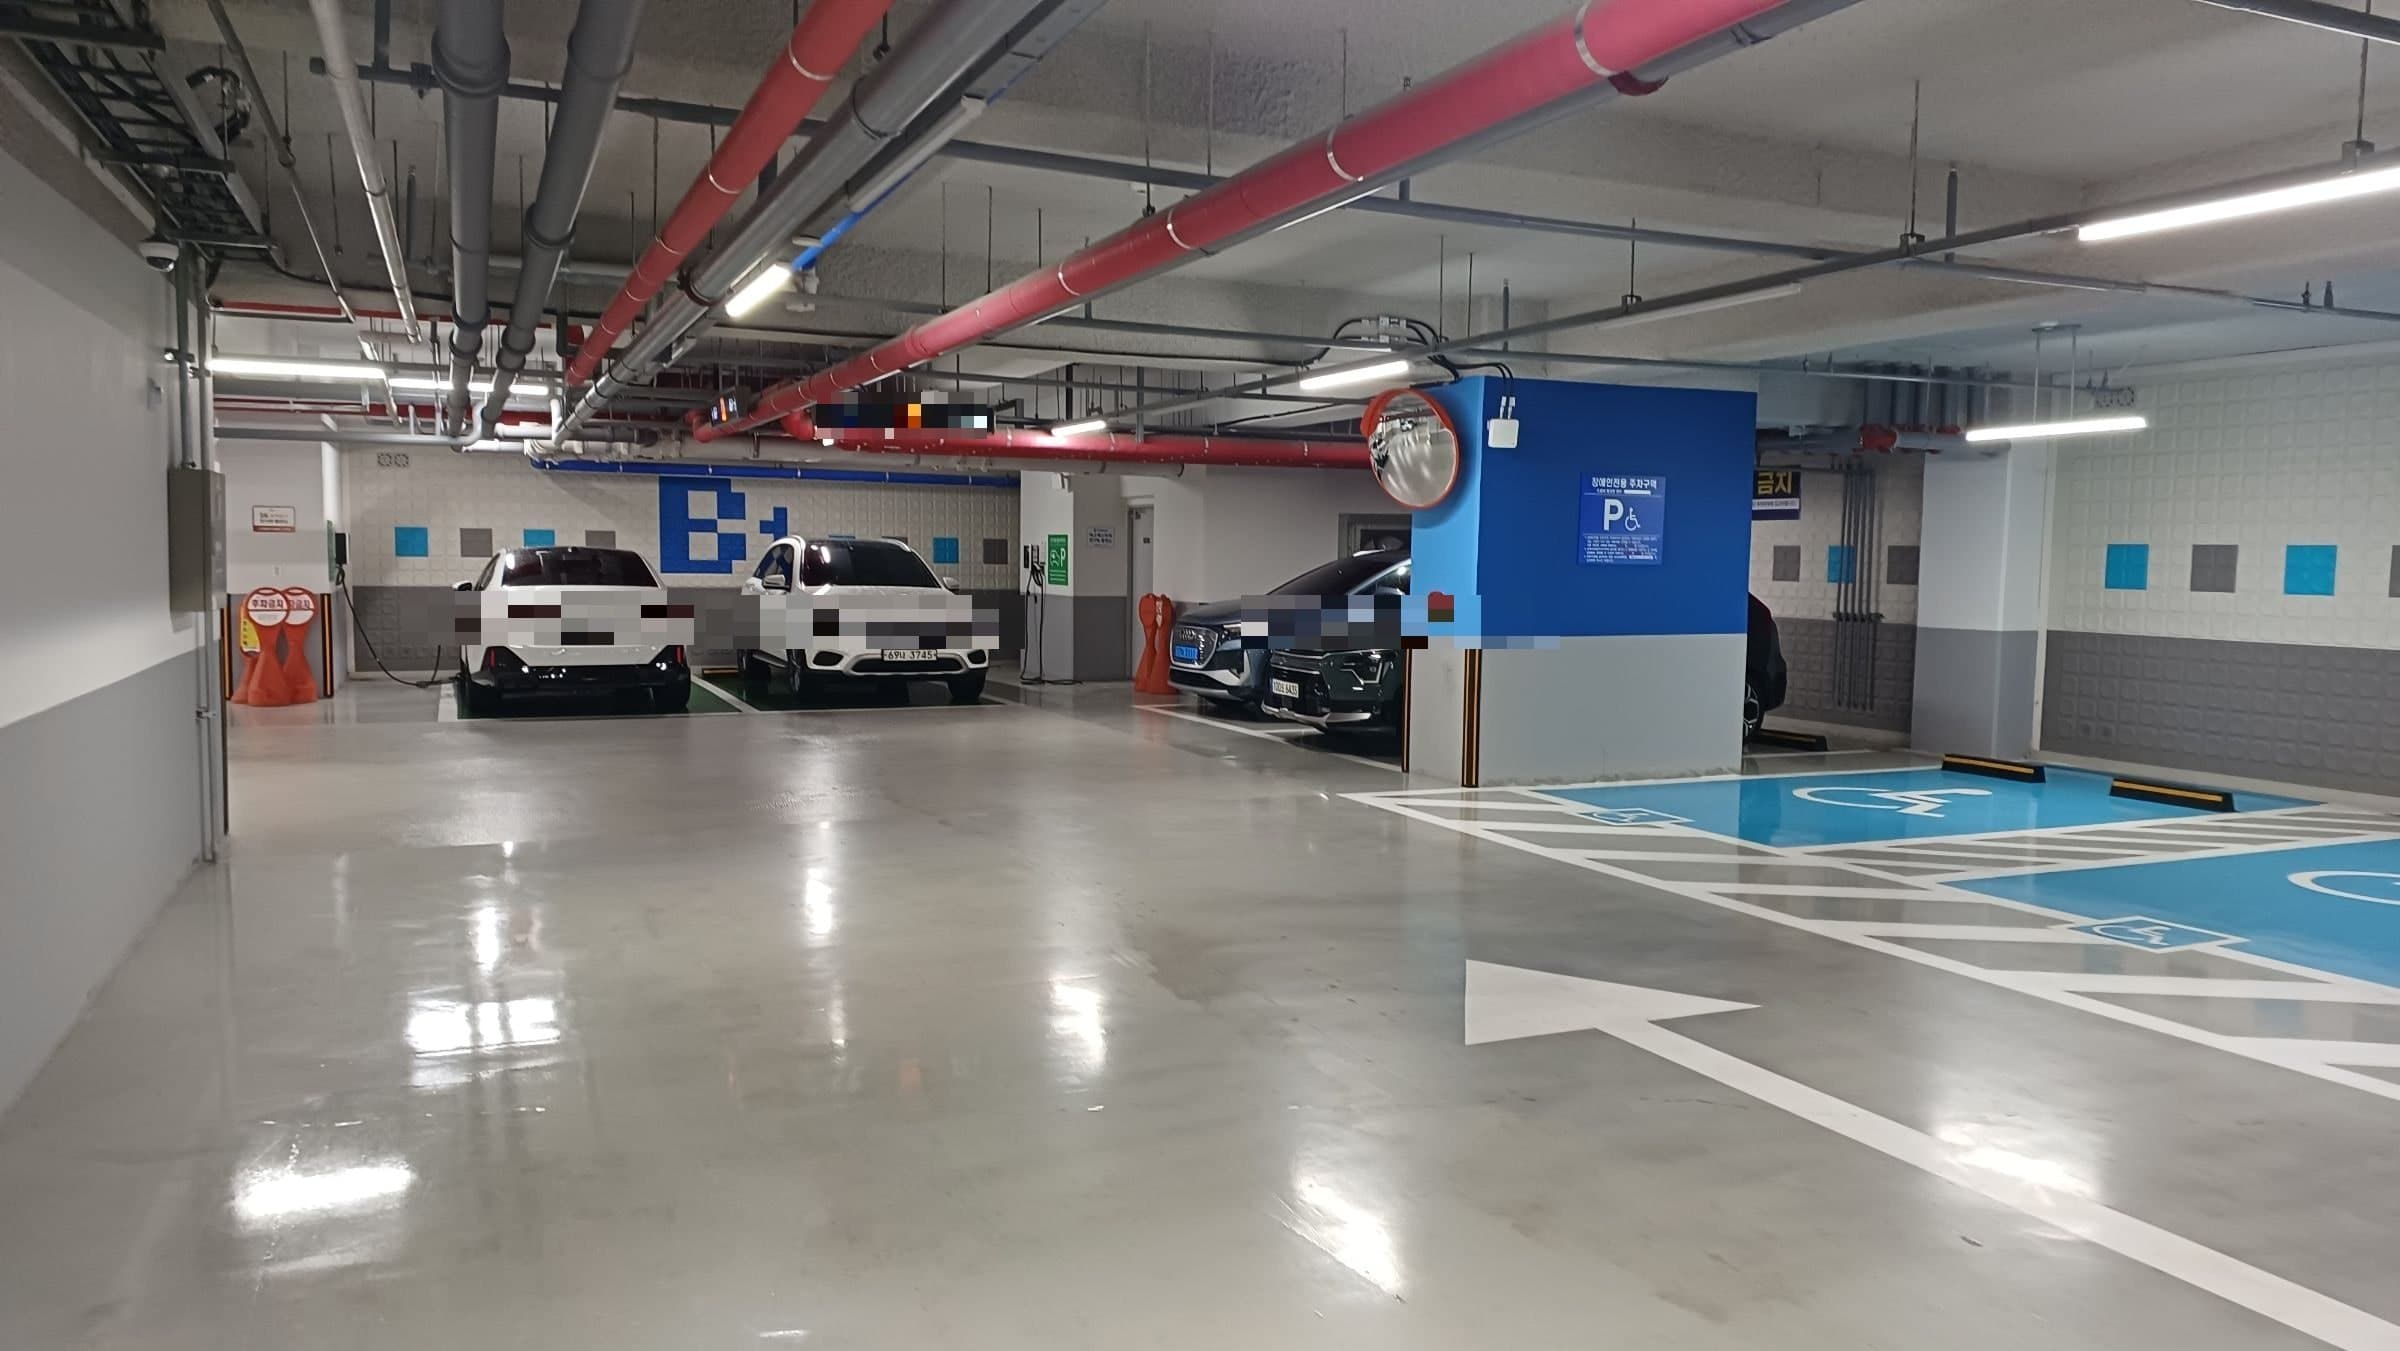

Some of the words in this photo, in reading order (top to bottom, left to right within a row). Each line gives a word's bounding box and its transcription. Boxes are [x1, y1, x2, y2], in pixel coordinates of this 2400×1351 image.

[1591, 476, 1627, 488] 장애인전용
[1629, 478, 1657, 489] 주차구역
[1757, 471, 1793, 495] 금지
[1603, 498, 1624, 531] P
[1060, 547, 1066, 567] P
[252, 599, 283, 608] 주차금지
